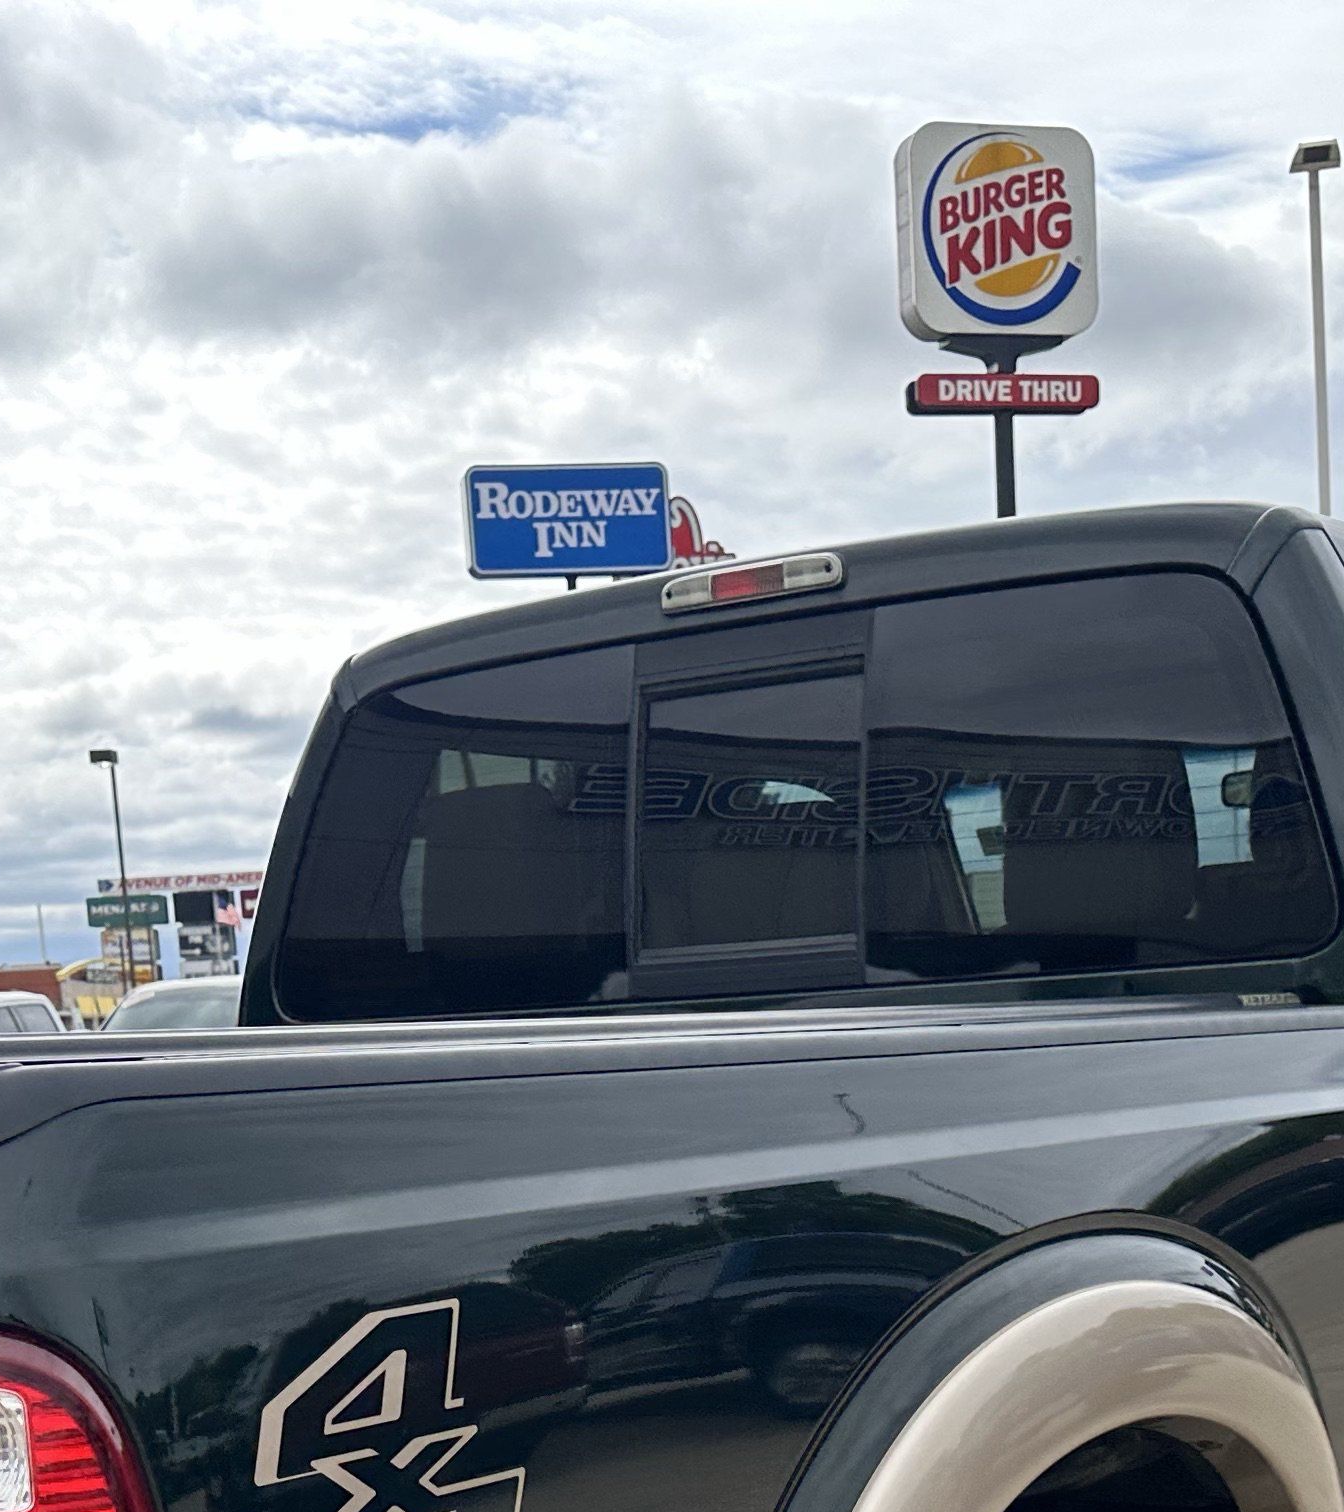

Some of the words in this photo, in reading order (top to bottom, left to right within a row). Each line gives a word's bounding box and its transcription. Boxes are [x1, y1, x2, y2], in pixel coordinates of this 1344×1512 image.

[939, 167, 1066, 235] BURGER
[946, 201, 1072, 286] KING
[938, 379, 1013, 402] DRIVE
[1019, 379, 1083, 402] THRU
[474, 482, 661, 520] RODEWAY
[533, 521, 608, 558] INN
[117, 877, 170, 891] AVENUE
[175, 875, 194, 888] OF
[196, 871, 262, 886] MID-AMER
